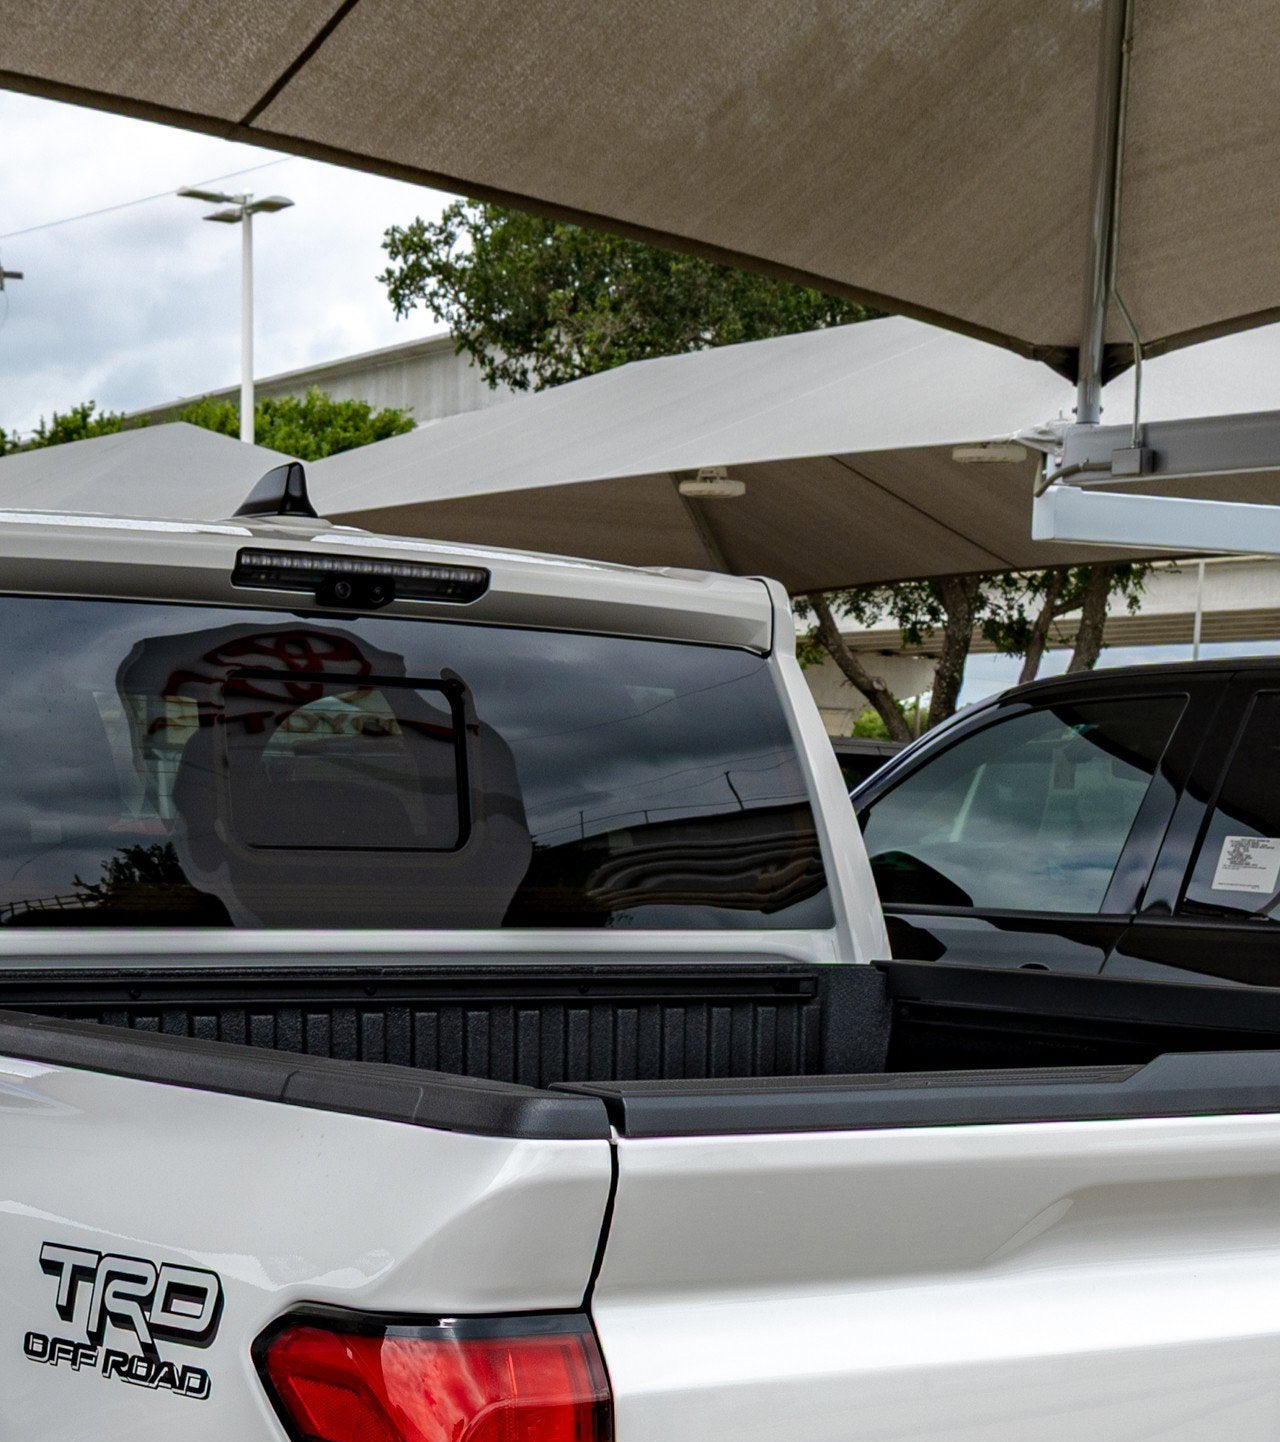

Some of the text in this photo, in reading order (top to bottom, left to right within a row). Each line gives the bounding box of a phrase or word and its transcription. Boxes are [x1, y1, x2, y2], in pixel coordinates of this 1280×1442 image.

[39, 1241, 225, 1360] TRD
[24, 1331, 212, 1400] OFF ROAD
